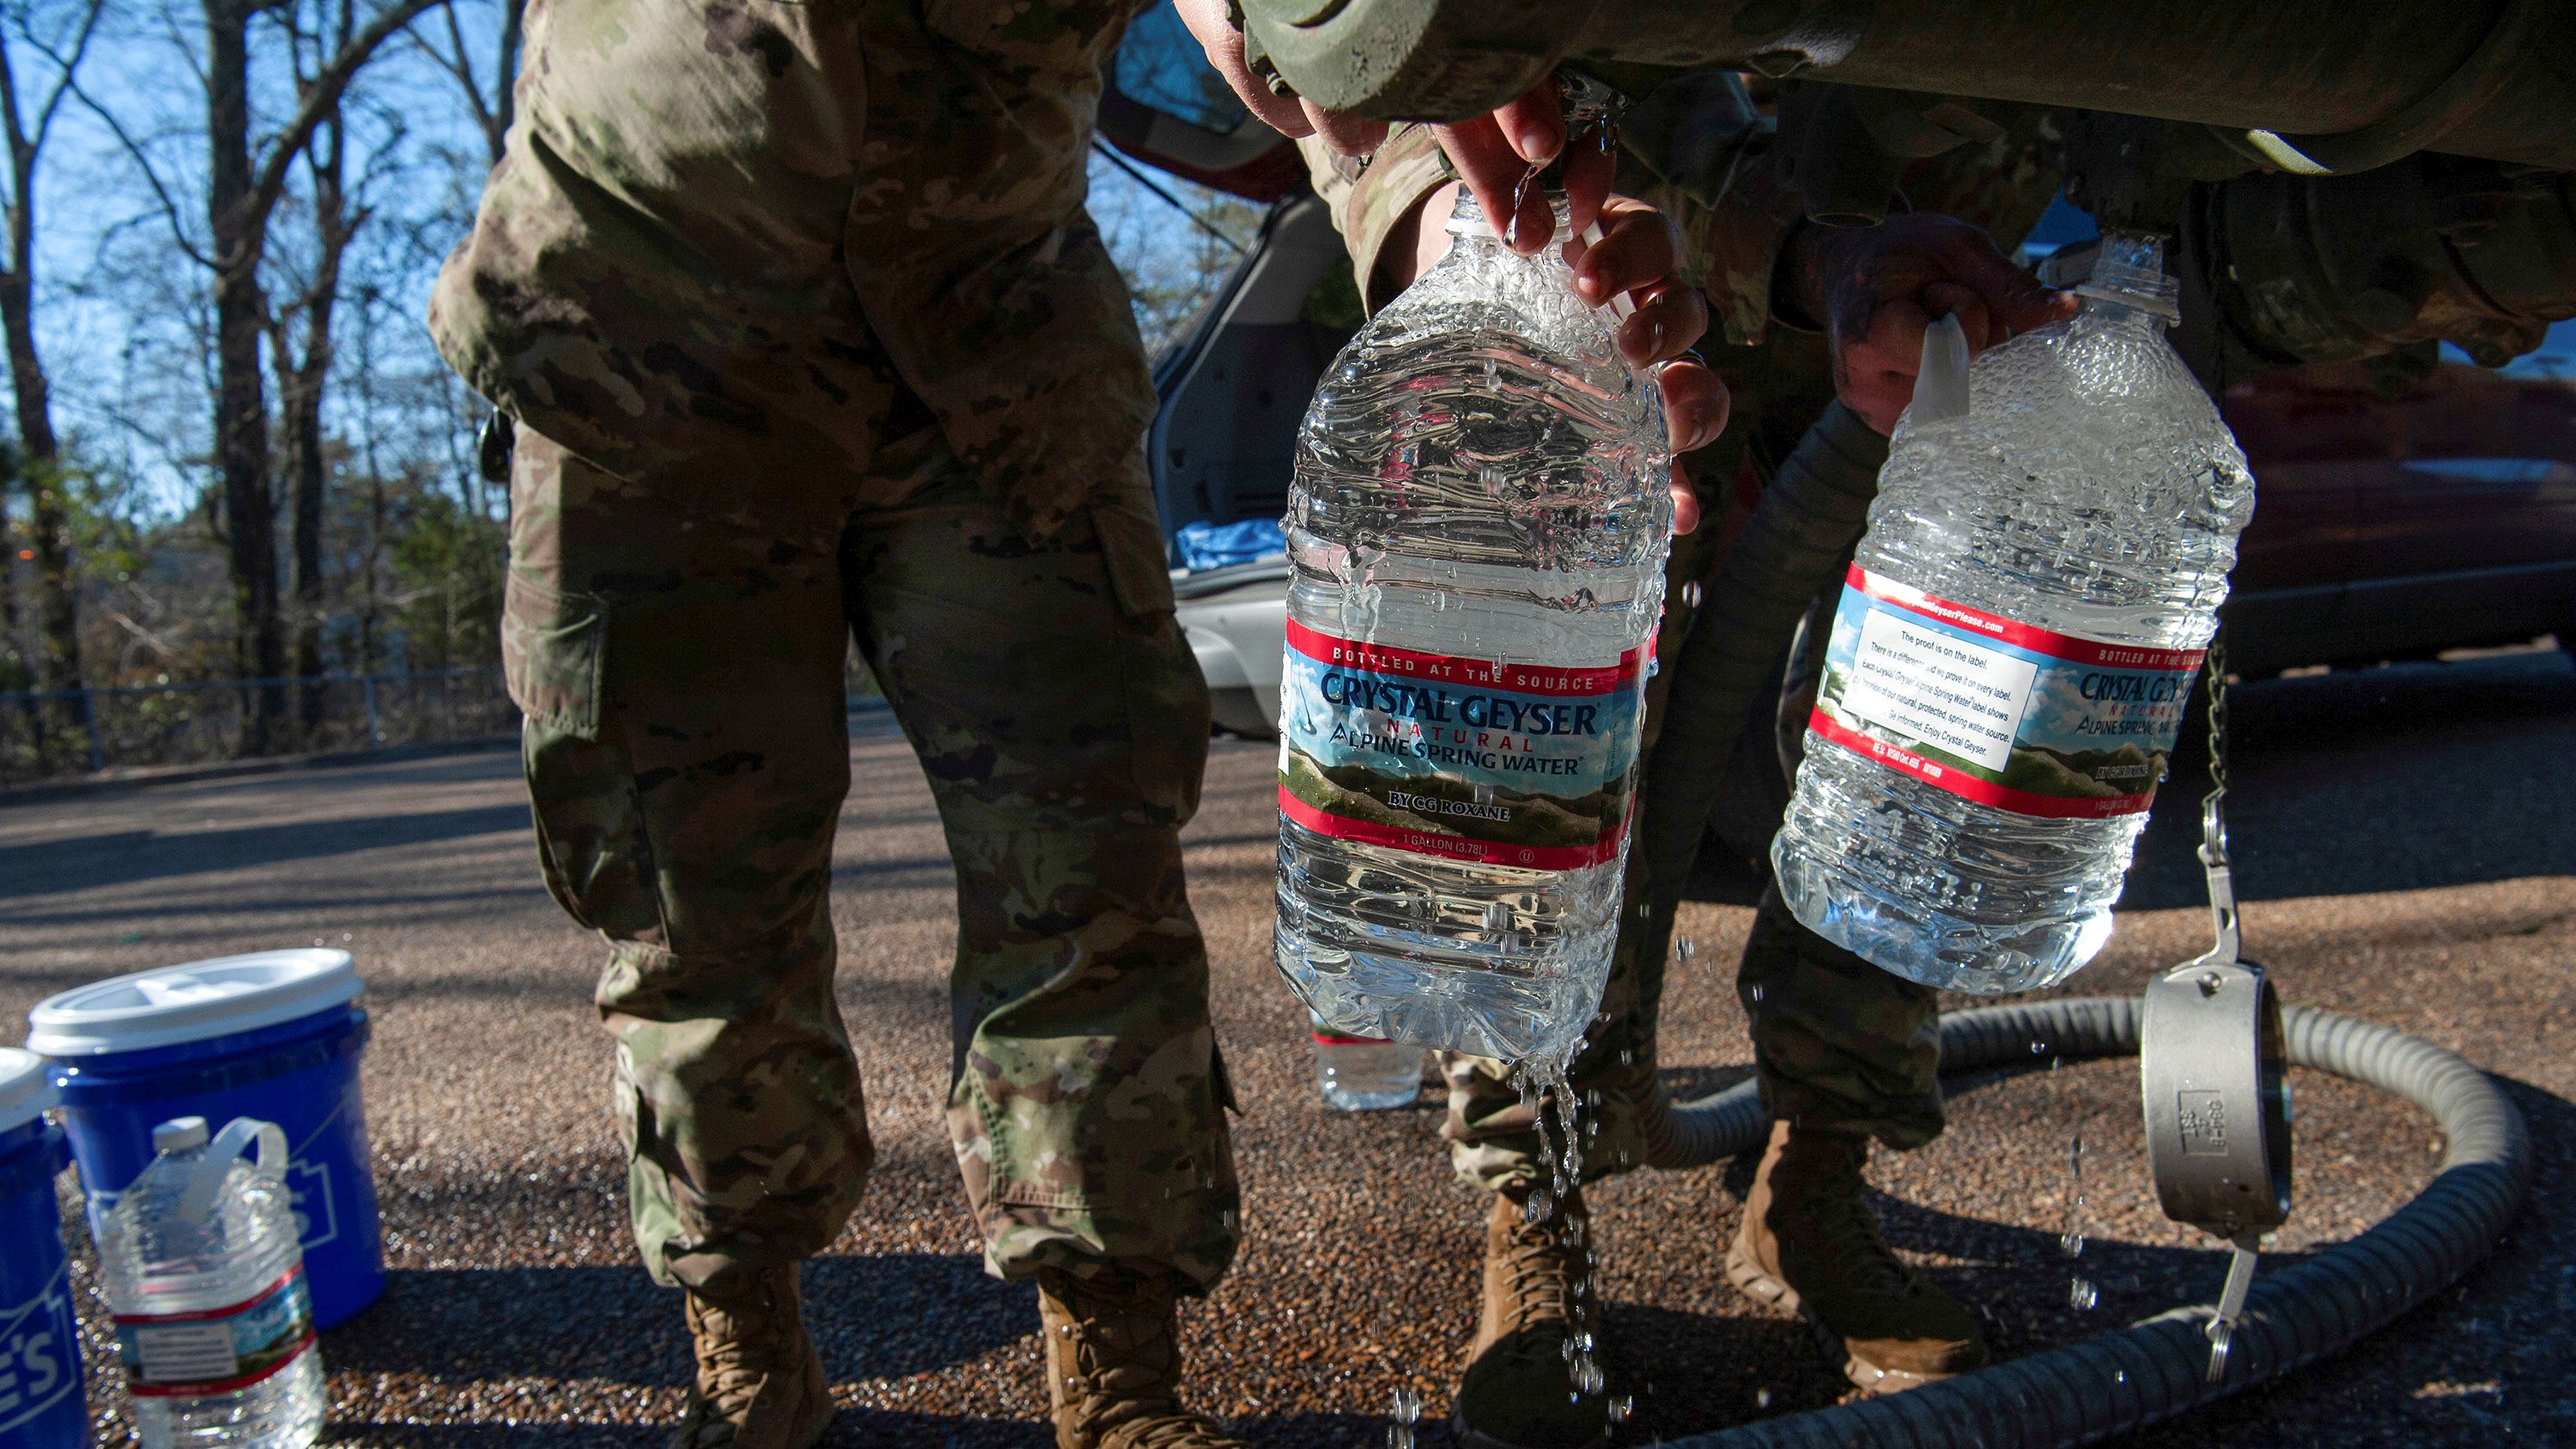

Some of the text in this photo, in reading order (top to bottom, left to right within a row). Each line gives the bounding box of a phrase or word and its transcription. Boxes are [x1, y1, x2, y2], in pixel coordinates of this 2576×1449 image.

[1334, 647, 1594, 690] BOTTLED AT THE SOURCE
[1901, 630, 1987, 669] The proof is on the label.
[2099, 650, 2144, 663] BOTTLED
[2148, 654, 2160, 665] AT
[2165, 655, 2180, 666] THE
[1862, 660, 1875, 670] Each
[1934, 686, 1953, 703] Spring
[1971, 700, 1987, 714] label
[1987, 707, 2009, 721] shows
[1871, 642, 1886, 655] There
[1886, 648, 1892, 657] is
[1945, 672, 1963, 682] prove
[1963, 675, 1968, 685] it
[1977, 683, 1993, 697] every
[1994, 687, 2011, 701] label.
[2080, 673, 2148, 702] CRYSTAL
[1321, 673, 1452, 722] CRYSTAL
[1460, 694, 1596, 736] GEYSER
[1881, 687, 1888, 696] of
[1887, 691, 1896, 699] our
[1896, 694, 1917, 709] natural,
[1917, 703, 1947, 720] protected,
[1948, 714, 1968, 729] spring
[1968, 721, 1985, 734] water
[1985, 728, 2009, 743] source.
[2109, 704, 2174, 717] NATURAL
[1387, 718, 1533, 752] NATURAL
[1898, 715, 1923, 730] informed.
[1924, 723, 1941, 740] Enjoy
[1941, 731, 1964, 746] Crystal
[1964, 740, 1986, 756] Geyser.
[2075, 715, 2118, 734] ALPINE
[1328, 721, 1409, 756] ALPINE
[1413, 741, 1496, 769] SPRING
[1388, 790, 1511, 822] BY CG ROXANE
[1403, 834, 1488, 856] 1 GALLON (3.78L)
